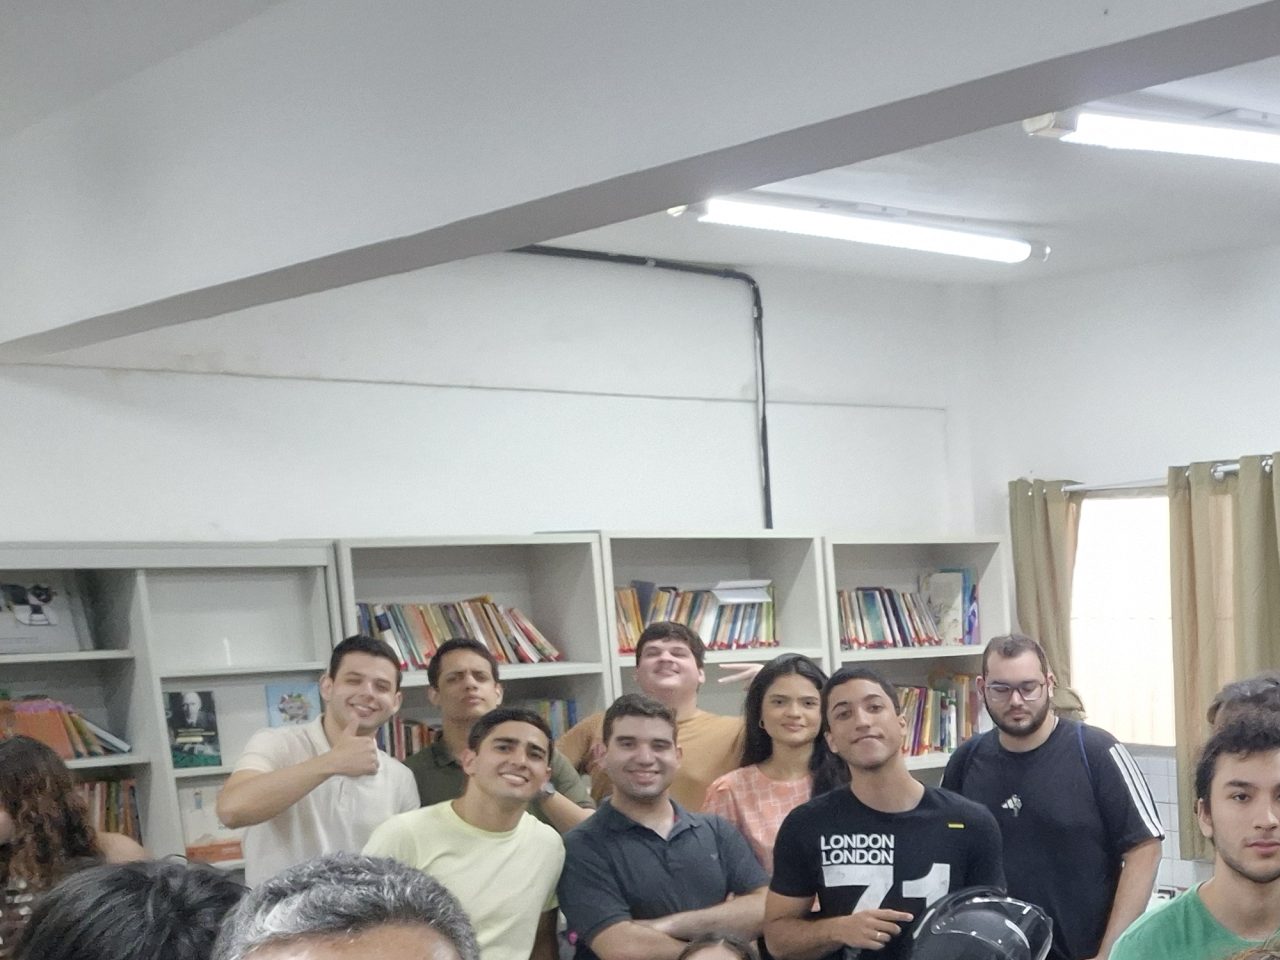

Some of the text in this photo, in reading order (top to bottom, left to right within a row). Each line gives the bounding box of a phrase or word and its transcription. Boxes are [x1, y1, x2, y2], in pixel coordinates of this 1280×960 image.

[820, 833, 895, 850] LONDON
[821, 849, 894, 865] LONDON
[821, 862, 950, 915] 71
